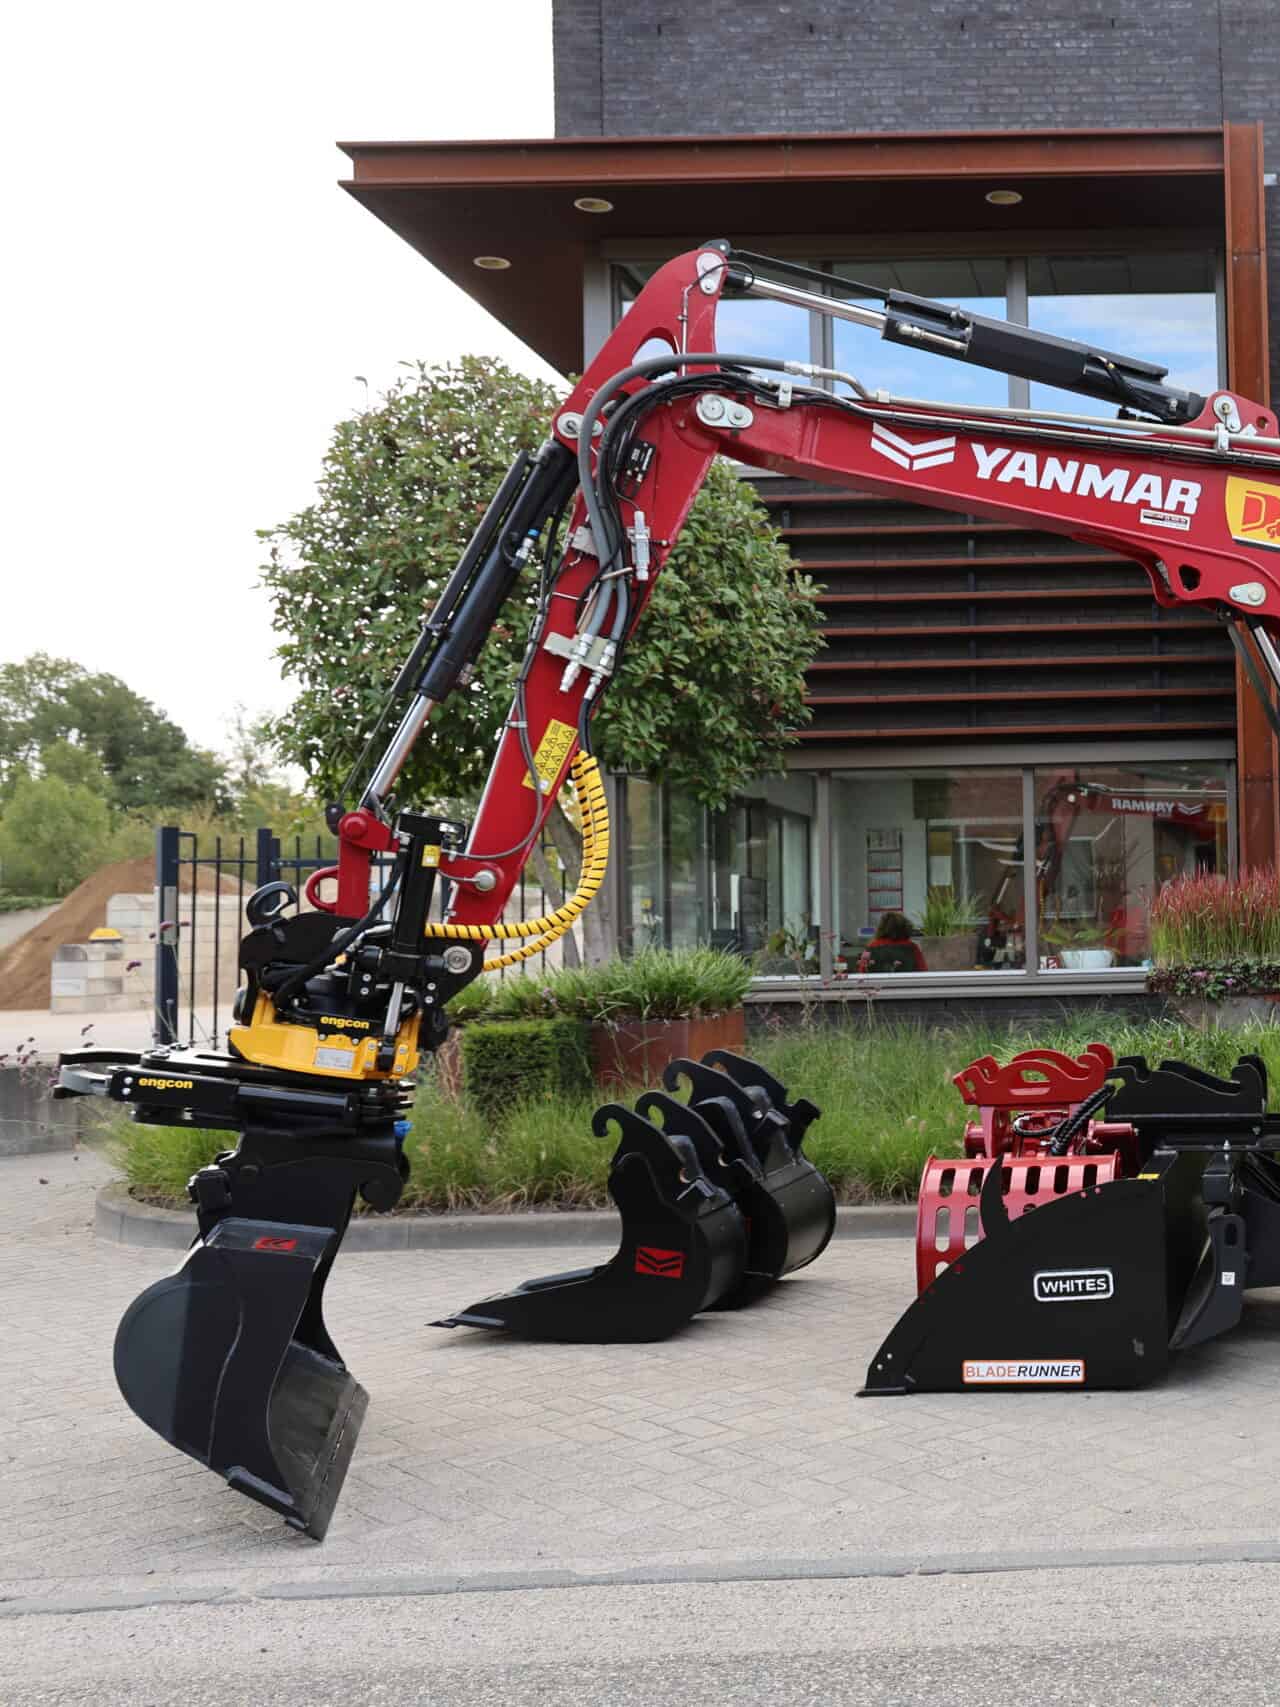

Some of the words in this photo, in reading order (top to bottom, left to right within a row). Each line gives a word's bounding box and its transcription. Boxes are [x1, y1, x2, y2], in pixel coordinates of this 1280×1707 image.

[970, 442, 1202, 515] YANMAR
[320, 1016, 370, 1029] engcon
[138, 1077, 193, 1090] engcon
[1041, 1278, 1107, 1294] WHITES
[965, 1365, 1081, 1378] BLADERUNNER
